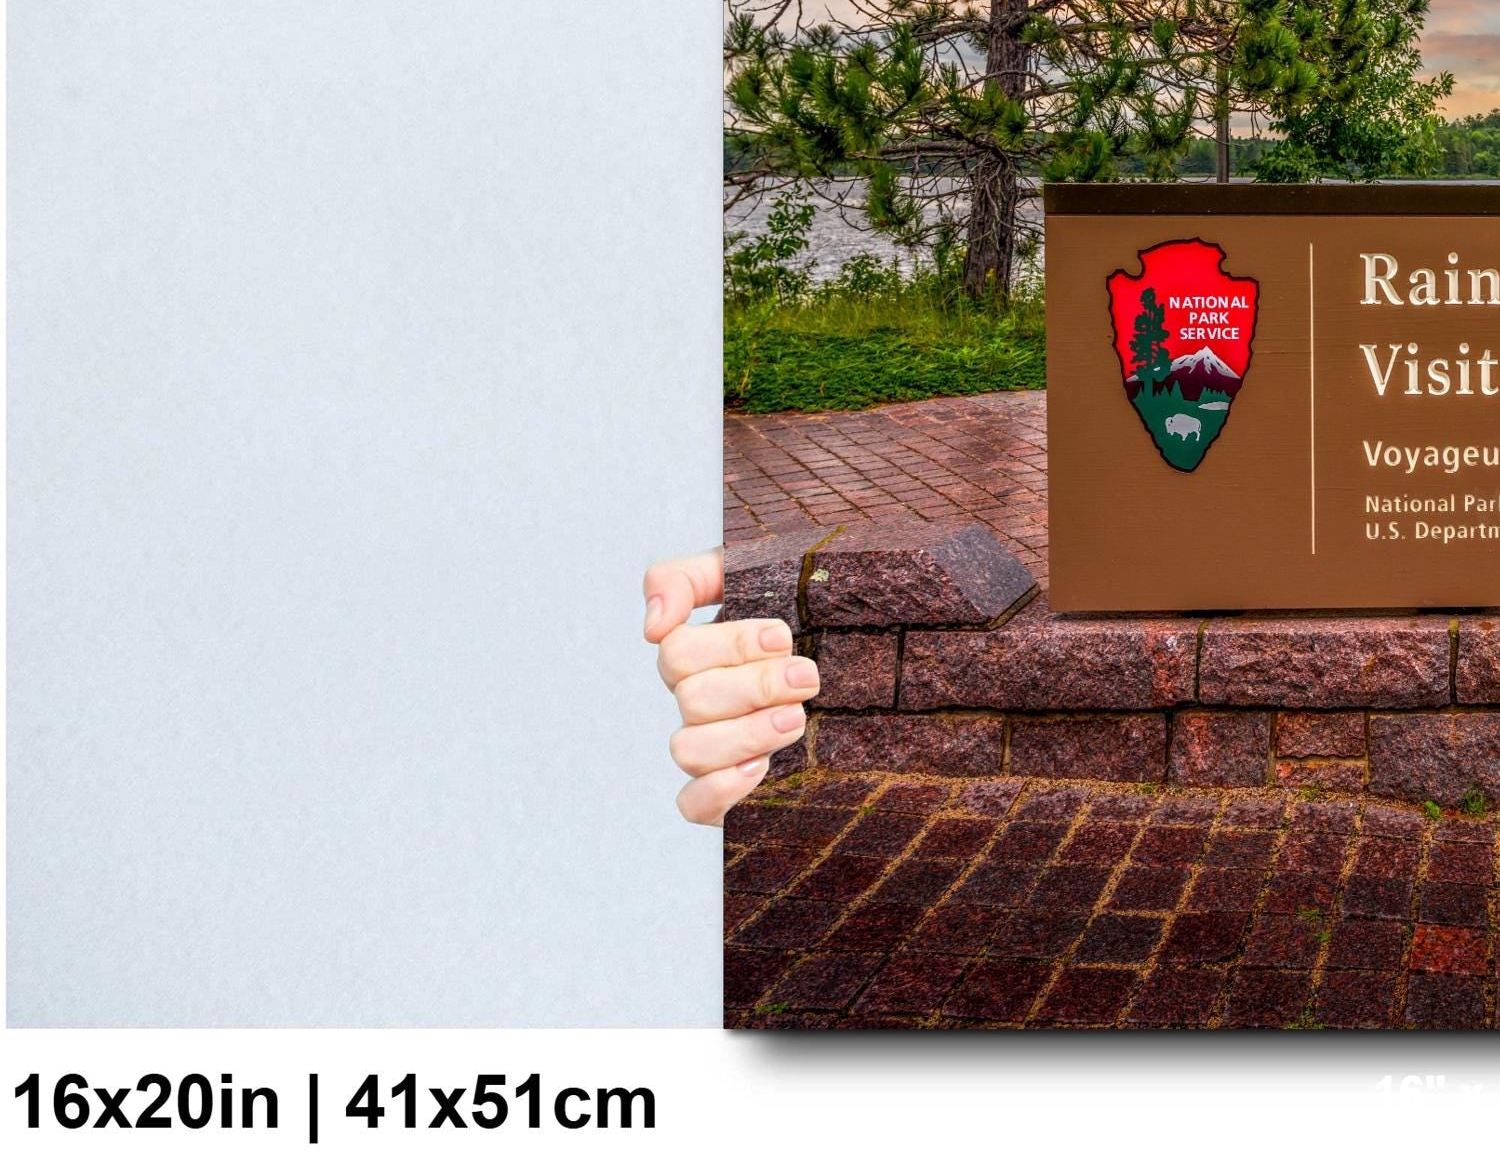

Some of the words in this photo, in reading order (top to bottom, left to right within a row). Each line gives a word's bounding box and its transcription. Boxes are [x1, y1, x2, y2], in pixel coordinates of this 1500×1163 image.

[1169, 295, 1249, 309] NATIONAL
[1189, 311, 1229, 324] PARK
[1180, 327, 1239, 340] SERVICE
[1365, 494, 1455, 512] National
[1365, 523, 1405, 540] U.S.
